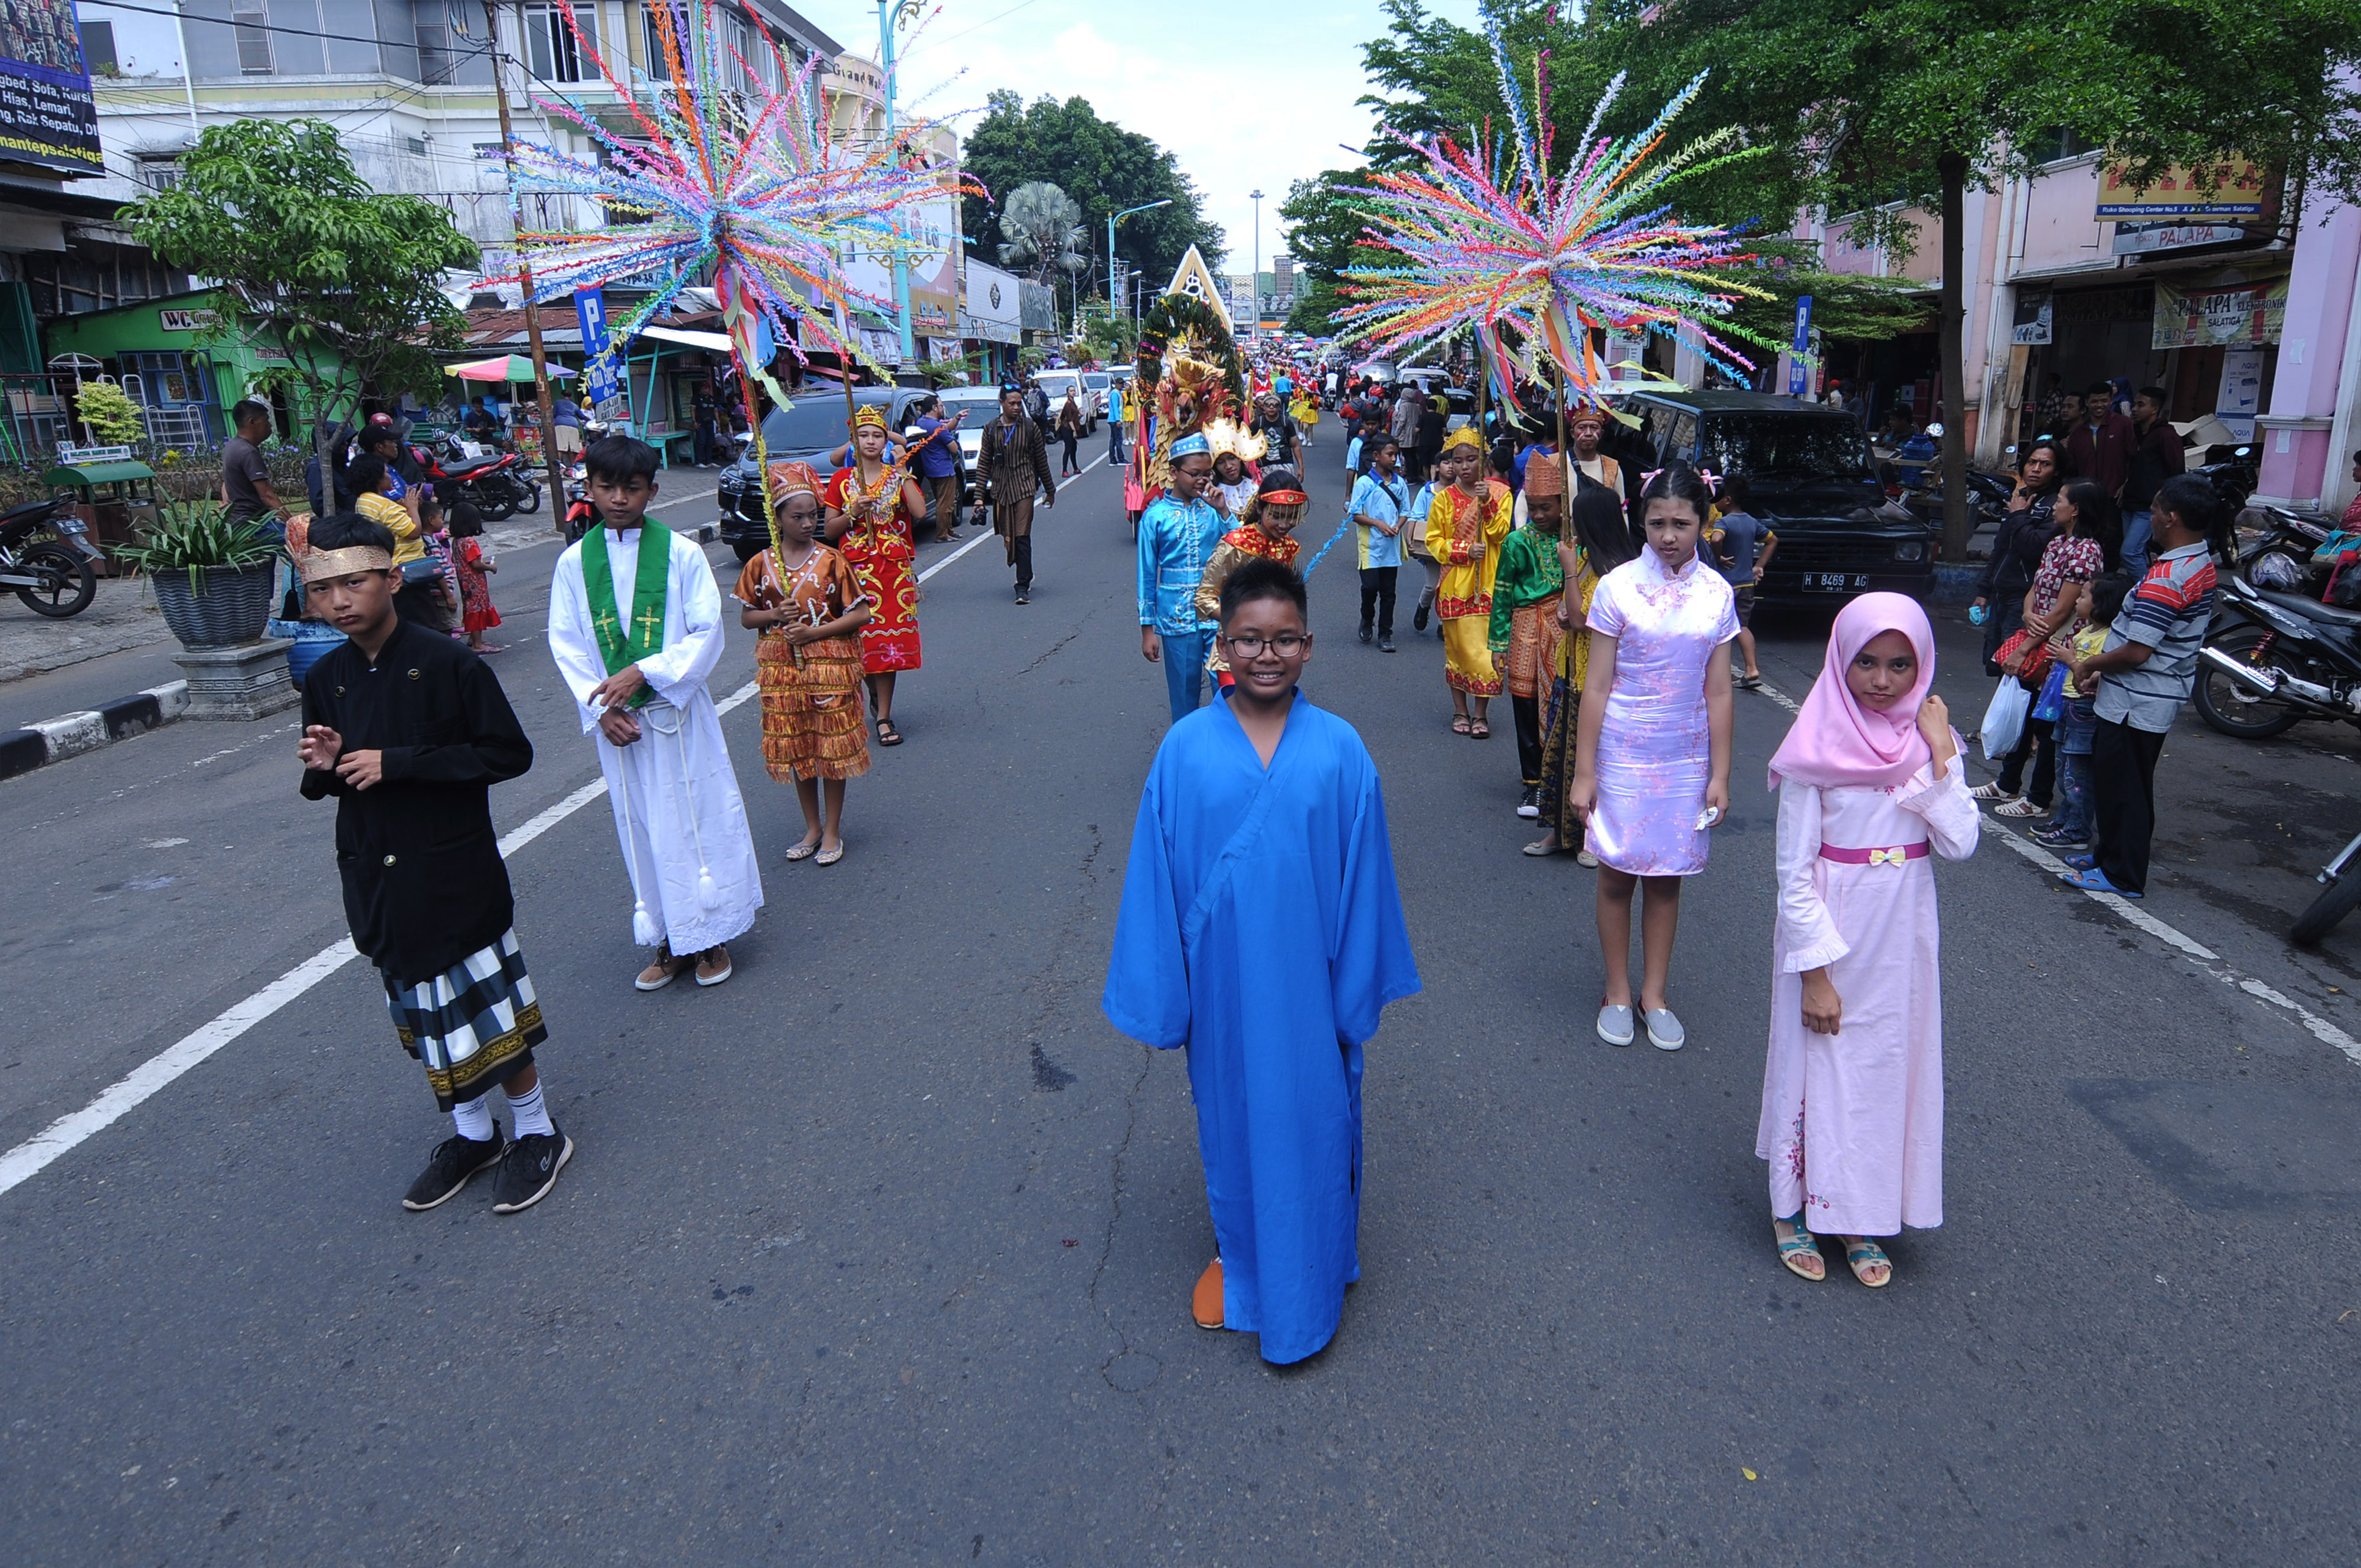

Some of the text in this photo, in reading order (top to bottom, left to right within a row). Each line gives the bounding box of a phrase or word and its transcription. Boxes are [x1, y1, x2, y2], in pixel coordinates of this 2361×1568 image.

[833, 63, 866, 83] Grand
[32, 80, 60, 100] Sofa,
[2, 90, 75, 118] Hias, Lemari,
[40, 114, 84, 136] Sepatu,
[2159, 226, 2214, 246] PALAPA
[2238, 298, 2286, 312] ELEKTRONIK
[164, 312, 192, 328] WC
[584, 297, 600, 341] P
[1797, 302, 1807, 338] P
[2208, 316, 2241, 327] SALATIGA
[1804, 574, 1867, 587] H 8469 AG
